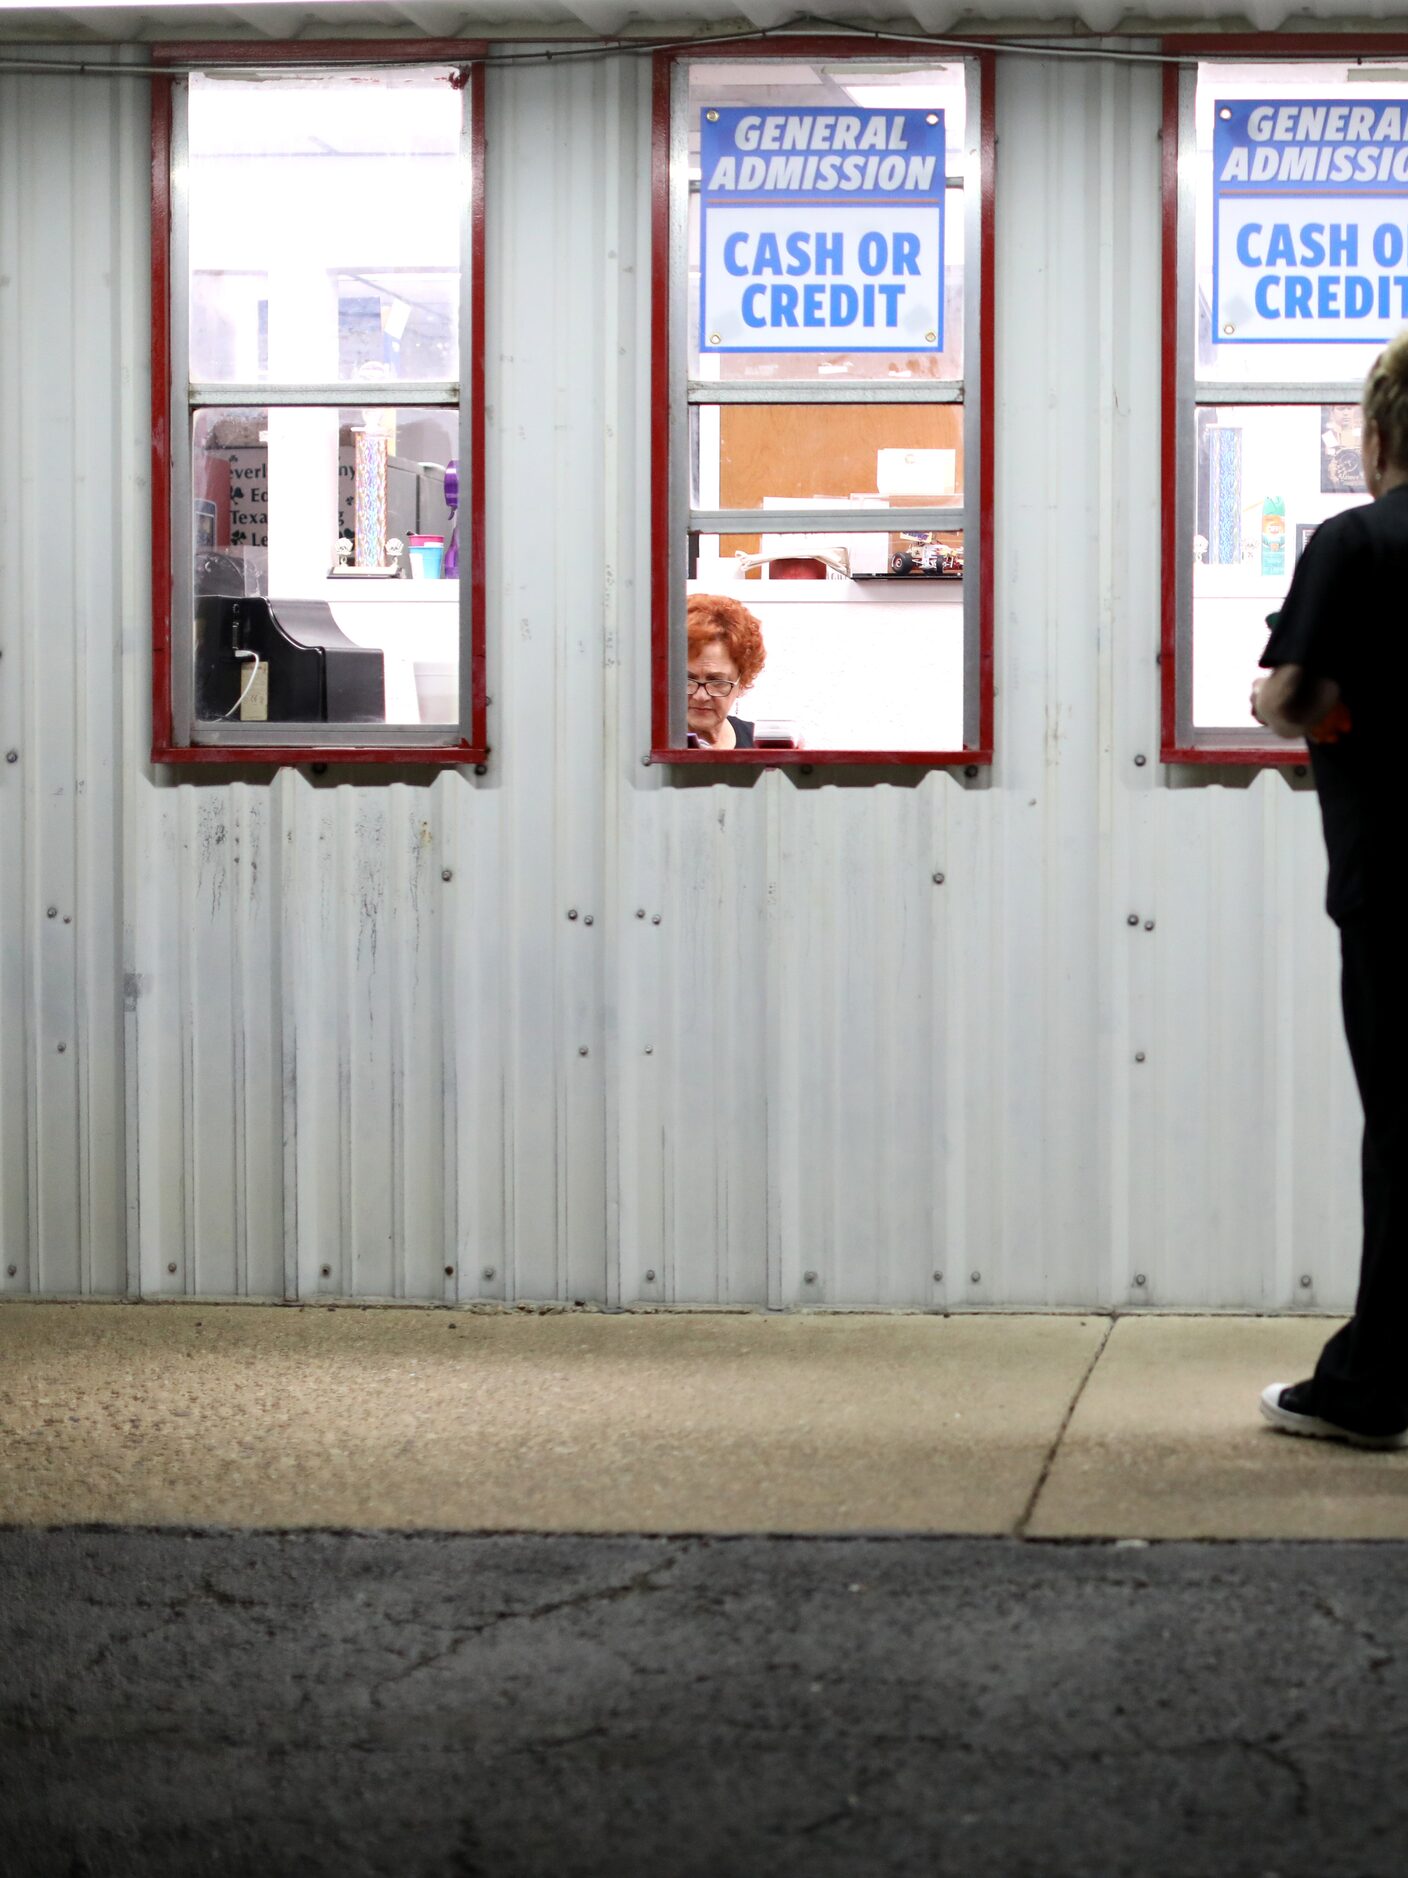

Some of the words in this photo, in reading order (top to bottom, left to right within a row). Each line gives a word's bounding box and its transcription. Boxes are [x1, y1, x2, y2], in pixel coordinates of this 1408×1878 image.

[734, 115, 908, 151] GENERAL
[707, 155, 936, 191] ADMISSION
[723, 231, 844, 277] CASH
[857, 231, 921, 276] OR
[1236, 223, 1358, 268] CASH
[741, 283, 906, 328] CREDIT
